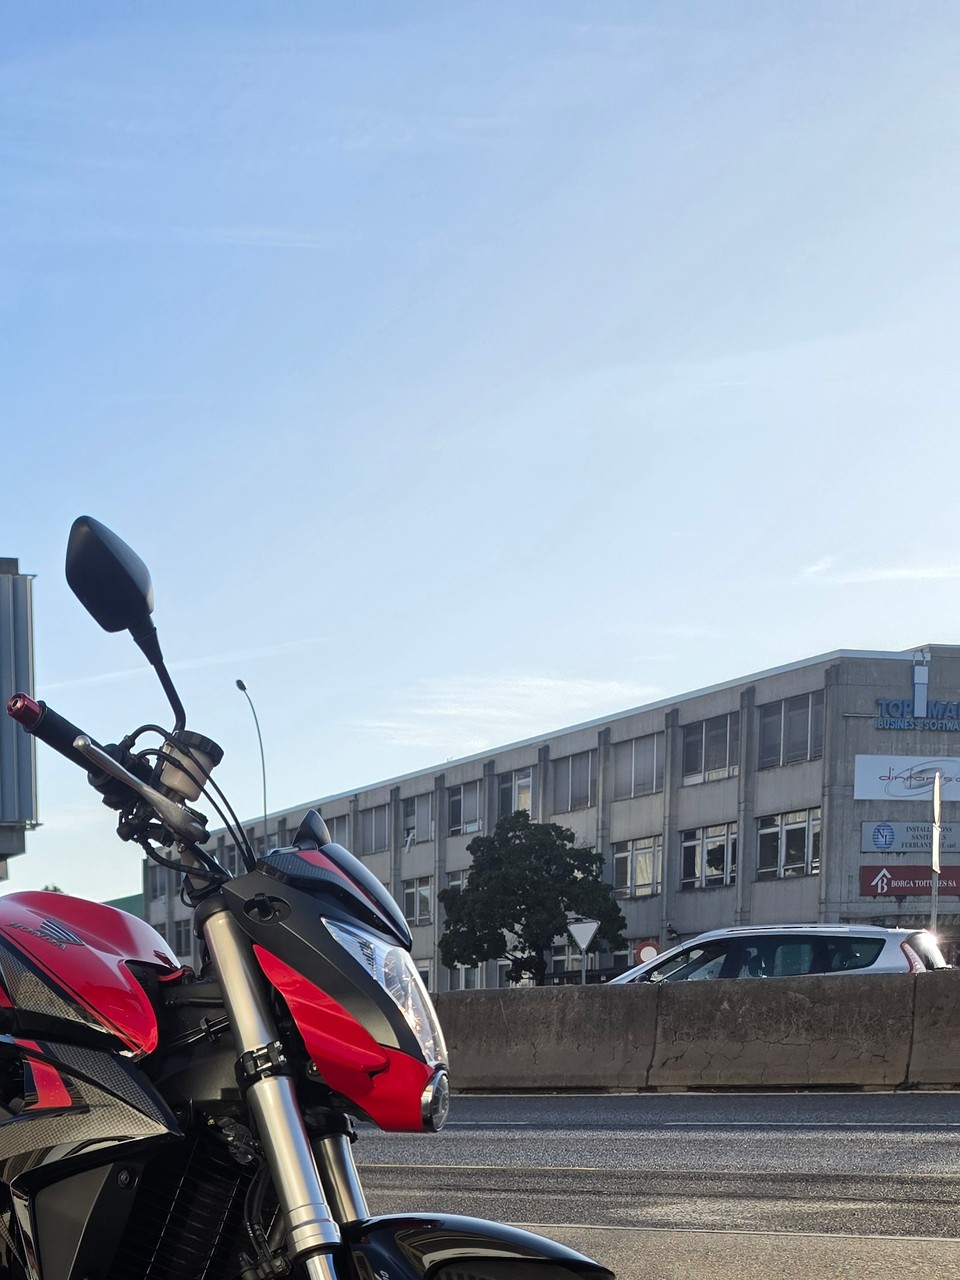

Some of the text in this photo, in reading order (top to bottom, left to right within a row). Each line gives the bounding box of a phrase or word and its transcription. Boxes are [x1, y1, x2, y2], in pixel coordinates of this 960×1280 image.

[878, 717, 920, 730] BUSINESS
[948, 880, 957, 888] SA
[6, 921, 67, 951] HONDA
